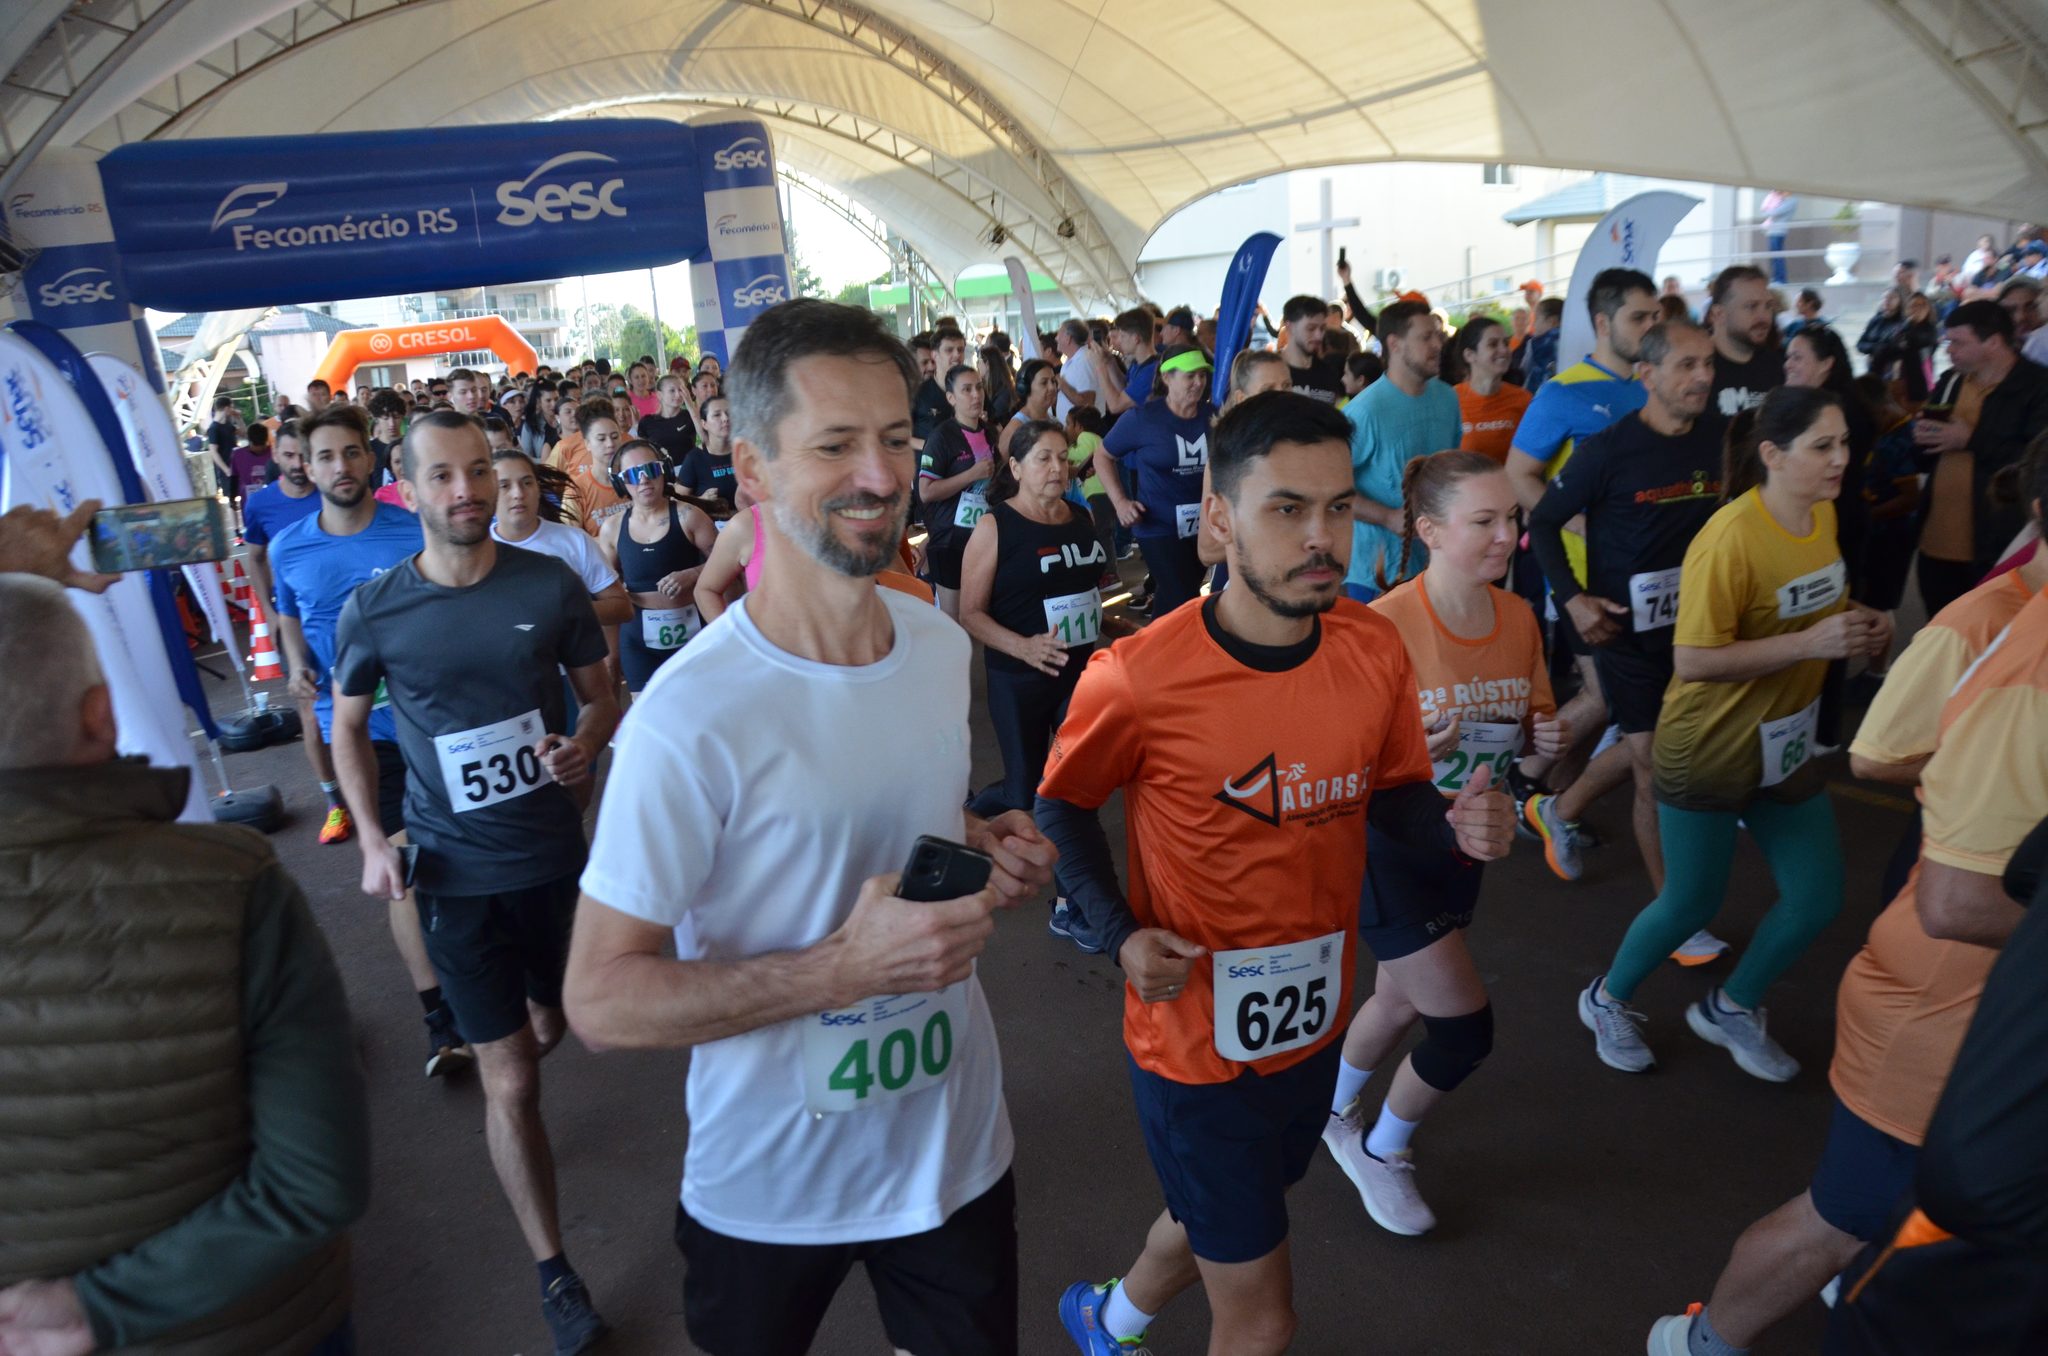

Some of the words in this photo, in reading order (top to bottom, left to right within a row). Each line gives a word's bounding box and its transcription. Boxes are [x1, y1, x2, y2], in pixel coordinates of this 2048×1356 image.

[714, 150, 767, 171] Sesc
[16, 204, 85, 218] Fecomércio
[87, 203, 104, 214] RS
[496, 178, 628, 227] Sesc
[232, 214, 410, 251] Fecomércio
[417, 208, 458, 235] RS
[720, 222, 770, 236] Fecomércio
[40, 281, 116, 307] Sesc
[733, 285, 786, 308] Sesc
[398, 327, 477, 349] CRESOL
[1037, 540, 1107, 574] FILA
[659, 624, 688, 646] 62
[1059, 608, 1099, 643] 111
[448, 742, 475, 754] Sesc
[461, 745, 541, 802] 530
[1228, 965, 1265, 978] Sesc
[820, 1012, 867, 1026] Sesc
[1237, 976, 1326, 1051] 625
[828, 1010, 953, 1099] 400
